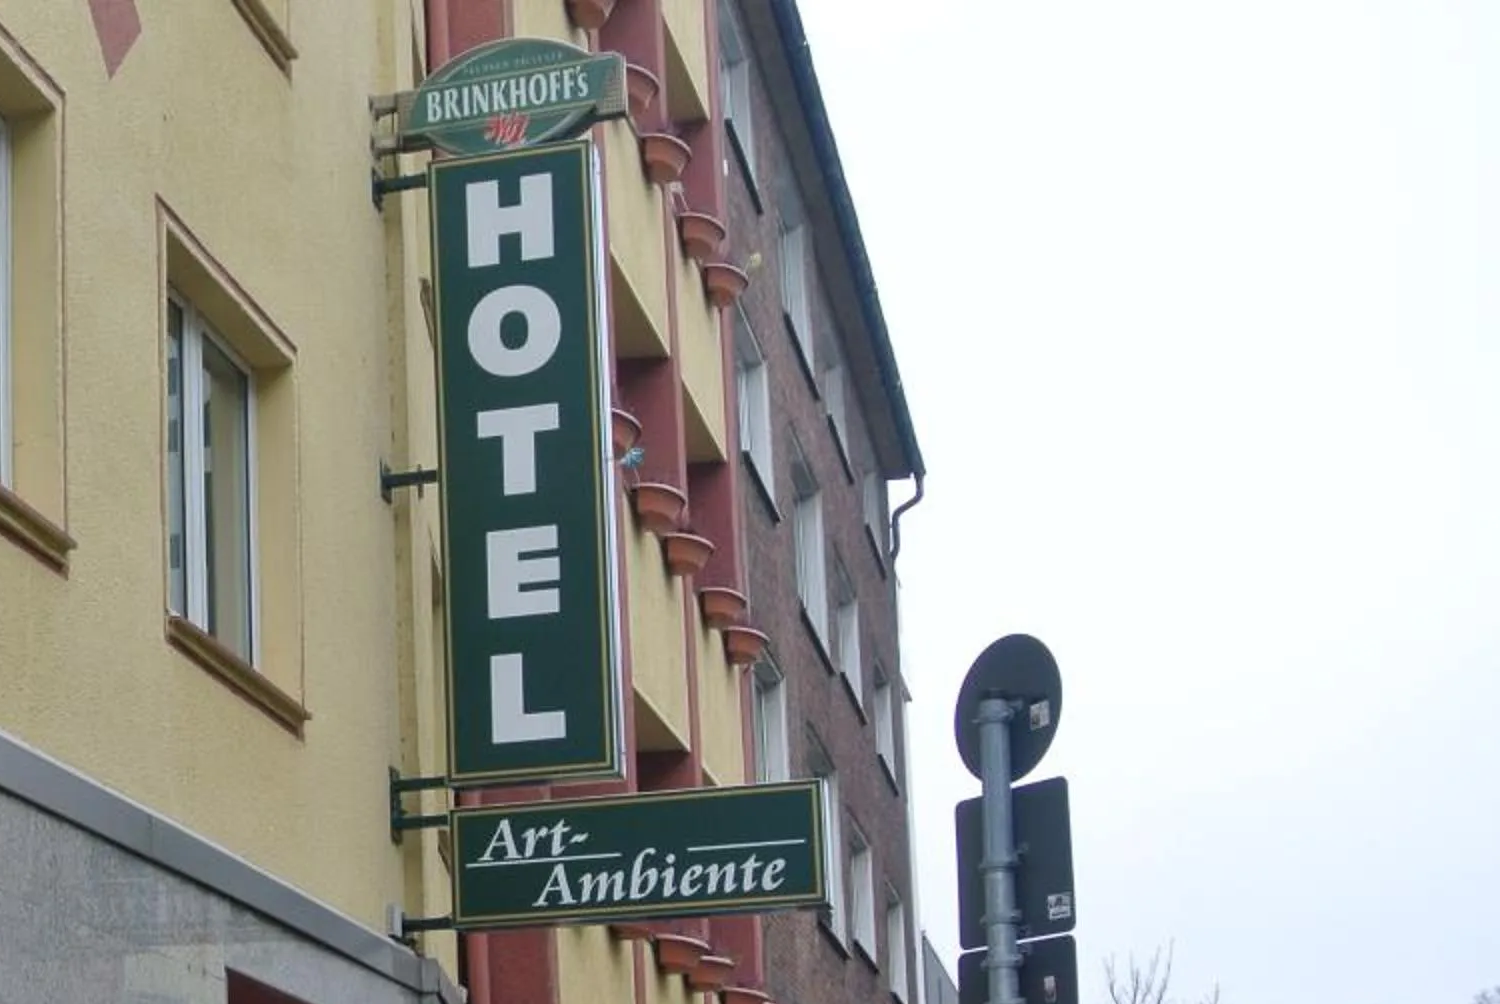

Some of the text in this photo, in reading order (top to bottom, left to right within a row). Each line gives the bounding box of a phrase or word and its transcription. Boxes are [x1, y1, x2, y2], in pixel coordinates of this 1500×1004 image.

[465, 172, 567, 745] HOTEL
[477, 817, 590, 863] Art-
[532, 847, 787, 907] Ambiente
